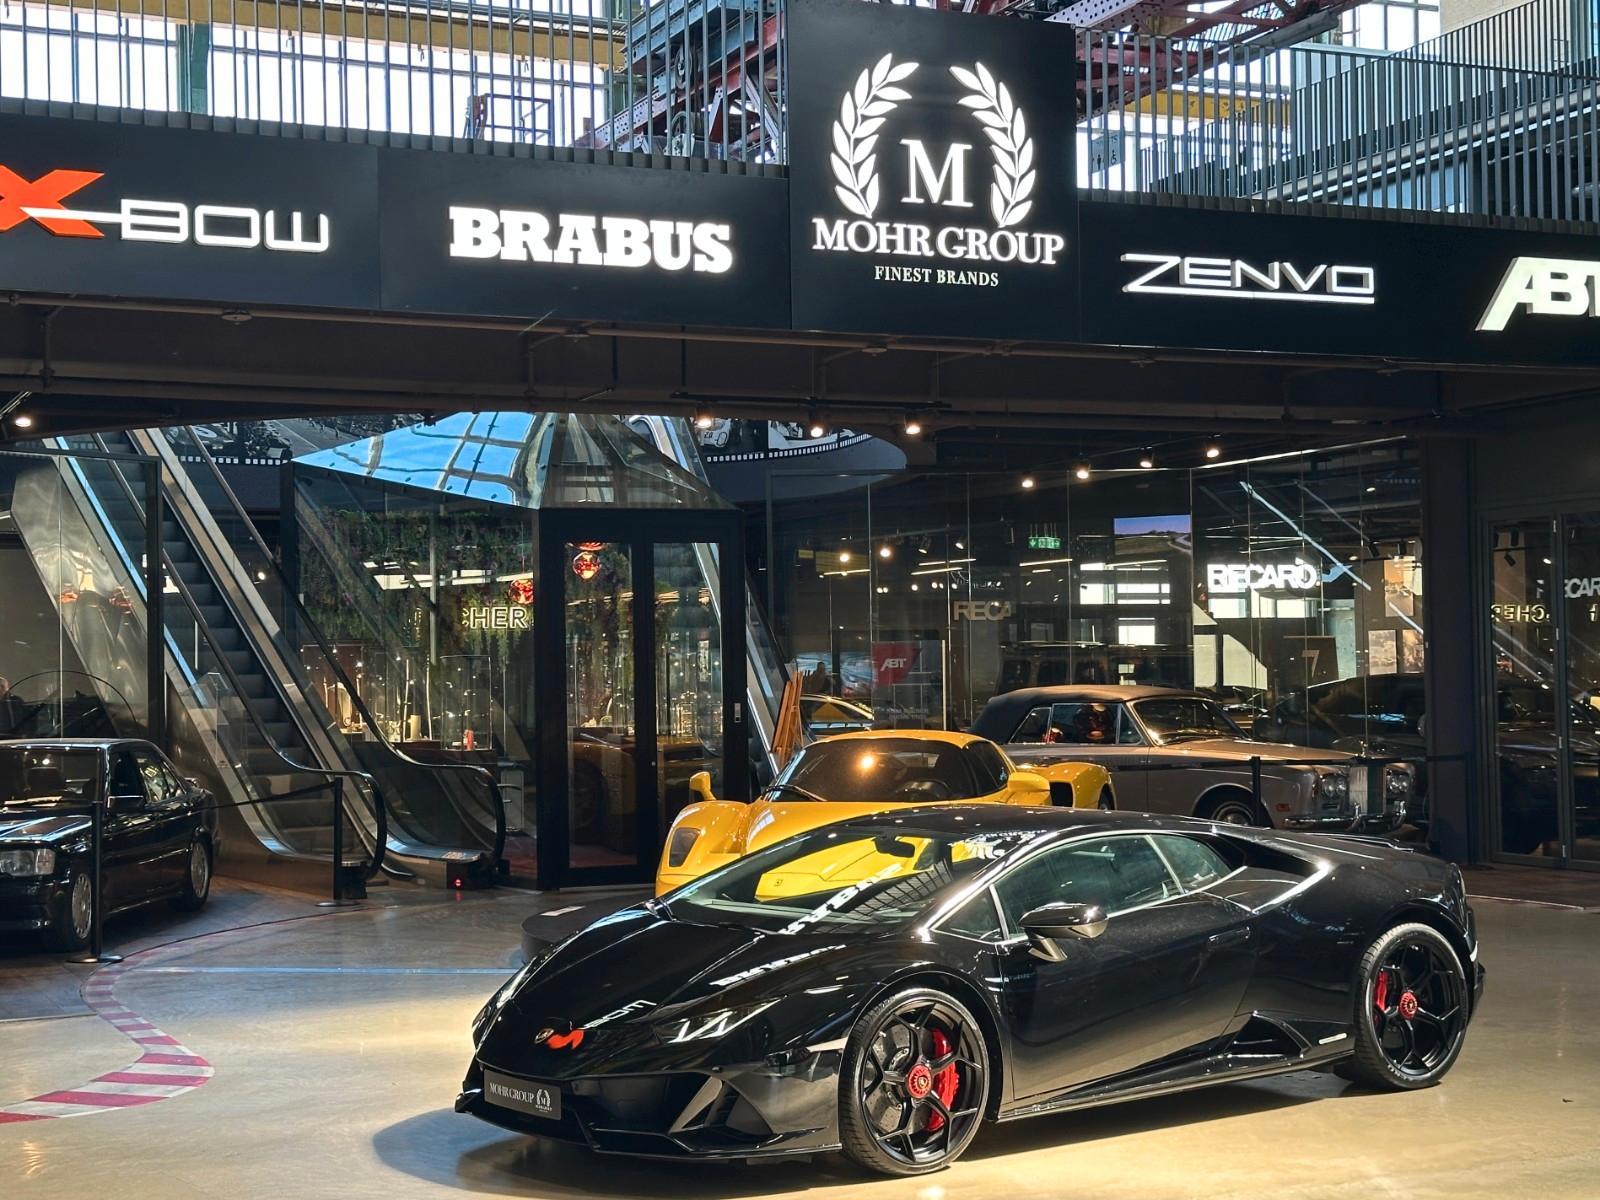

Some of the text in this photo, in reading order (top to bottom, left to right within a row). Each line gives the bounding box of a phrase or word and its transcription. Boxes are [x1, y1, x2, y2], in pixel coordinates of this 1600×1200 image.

[901, 138, 974, 208] M
[449, 205, 733, 274] BRABUS
[811, 217, 1065, 265] MOHR GROUP
[874, 265, 999, 287] FINEST BRANDS
[1120, 253, 1374, 304] ZENVO
[880, 657, 908, 672] ABT
[509, 1088, 535, 1104] GROUP
